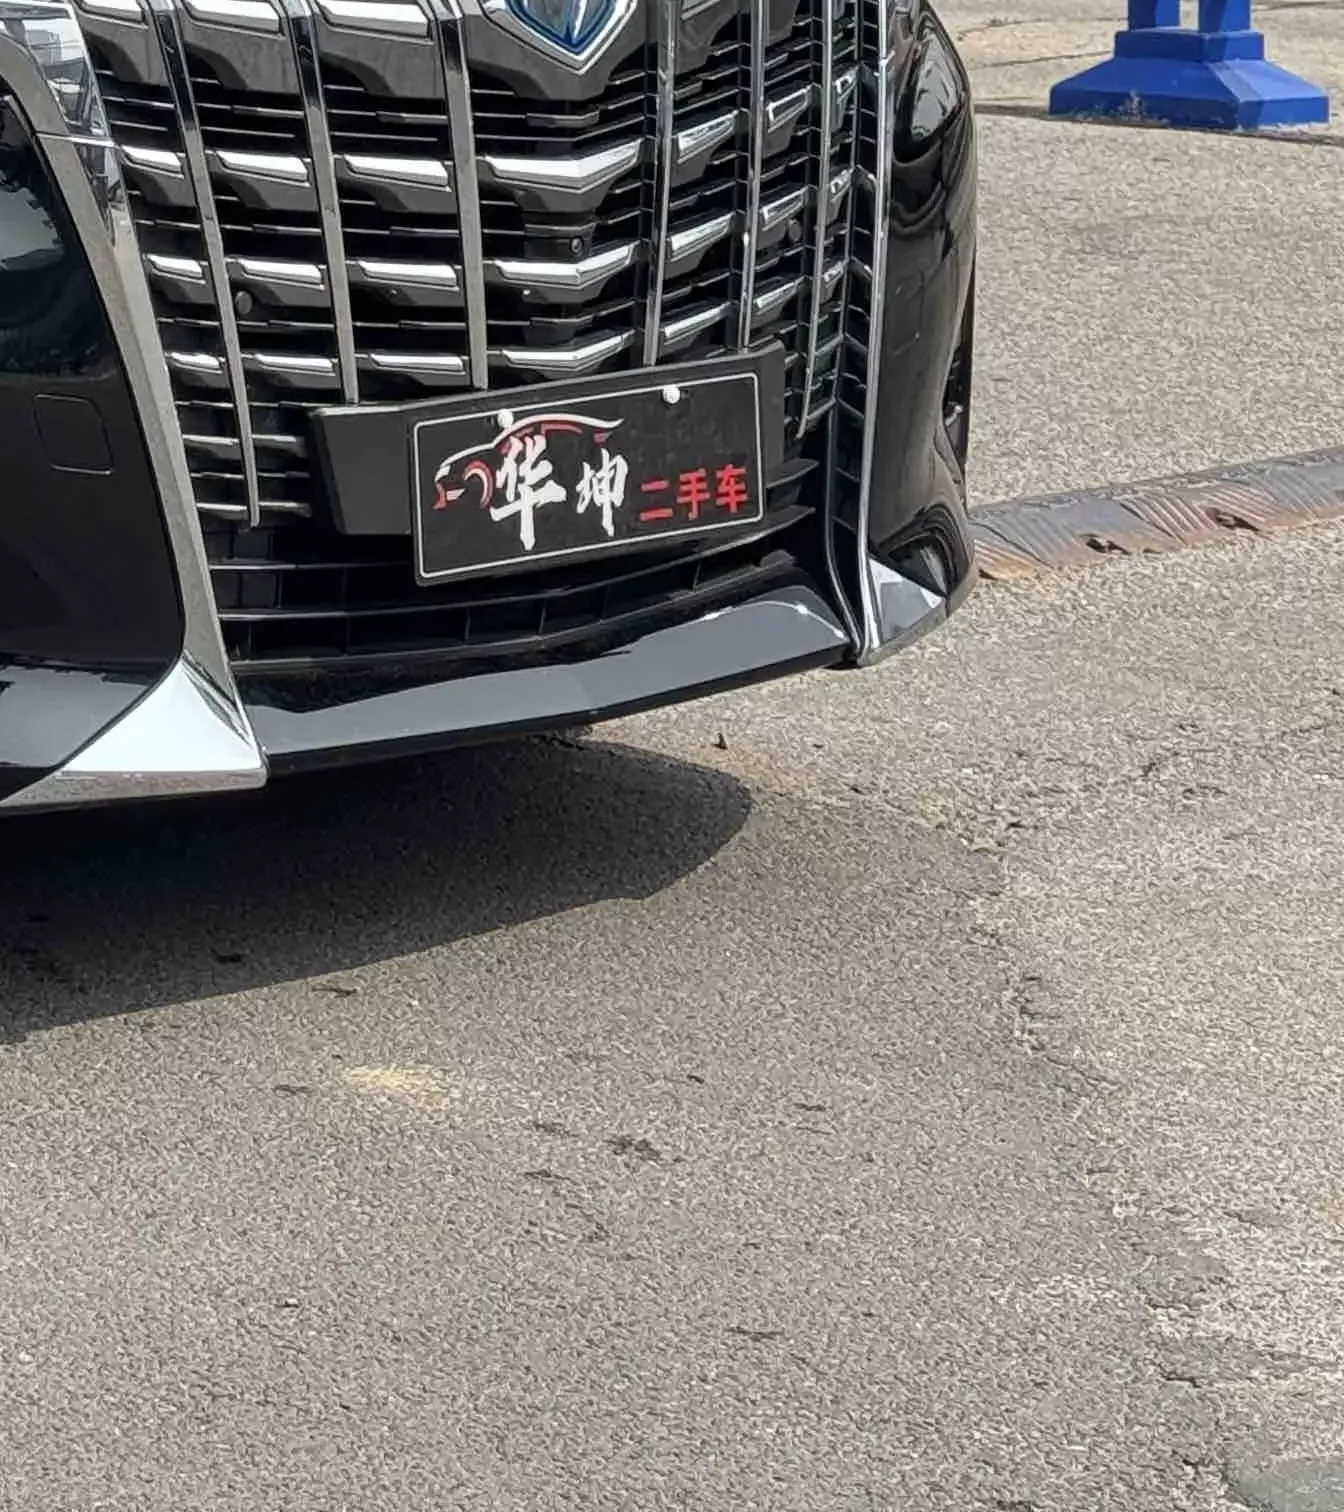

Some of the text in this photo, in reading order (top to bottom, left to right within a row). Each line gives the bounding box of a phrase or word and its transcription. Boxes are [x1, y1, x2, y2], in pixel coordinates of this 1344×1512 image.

[490, 433, 749, 550] 华坤 二手车
